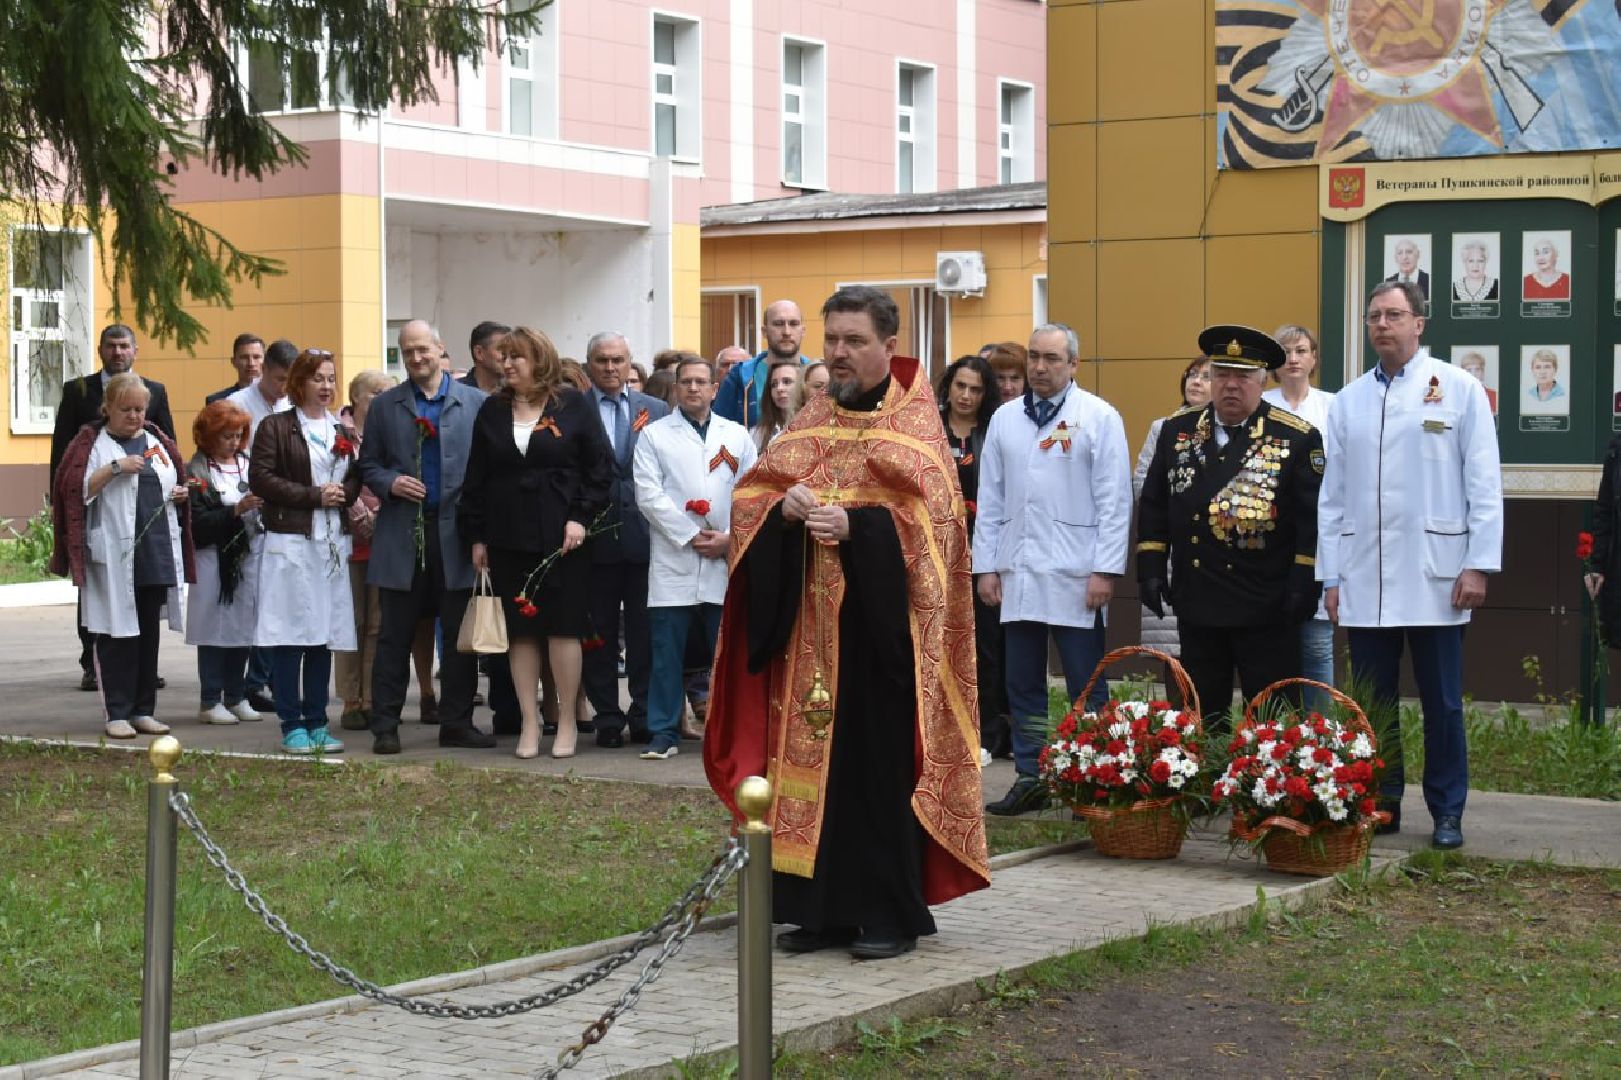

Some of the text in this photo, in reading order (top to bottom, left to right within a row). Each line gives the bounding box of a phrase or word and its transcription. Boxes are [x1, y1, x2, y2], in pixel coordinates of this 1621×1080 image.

[1376, 178, 1437, 192] Ветераны
[1441, 177, 1523, 191] Пушкинской
[1527, 174, 1590, 189] районной
